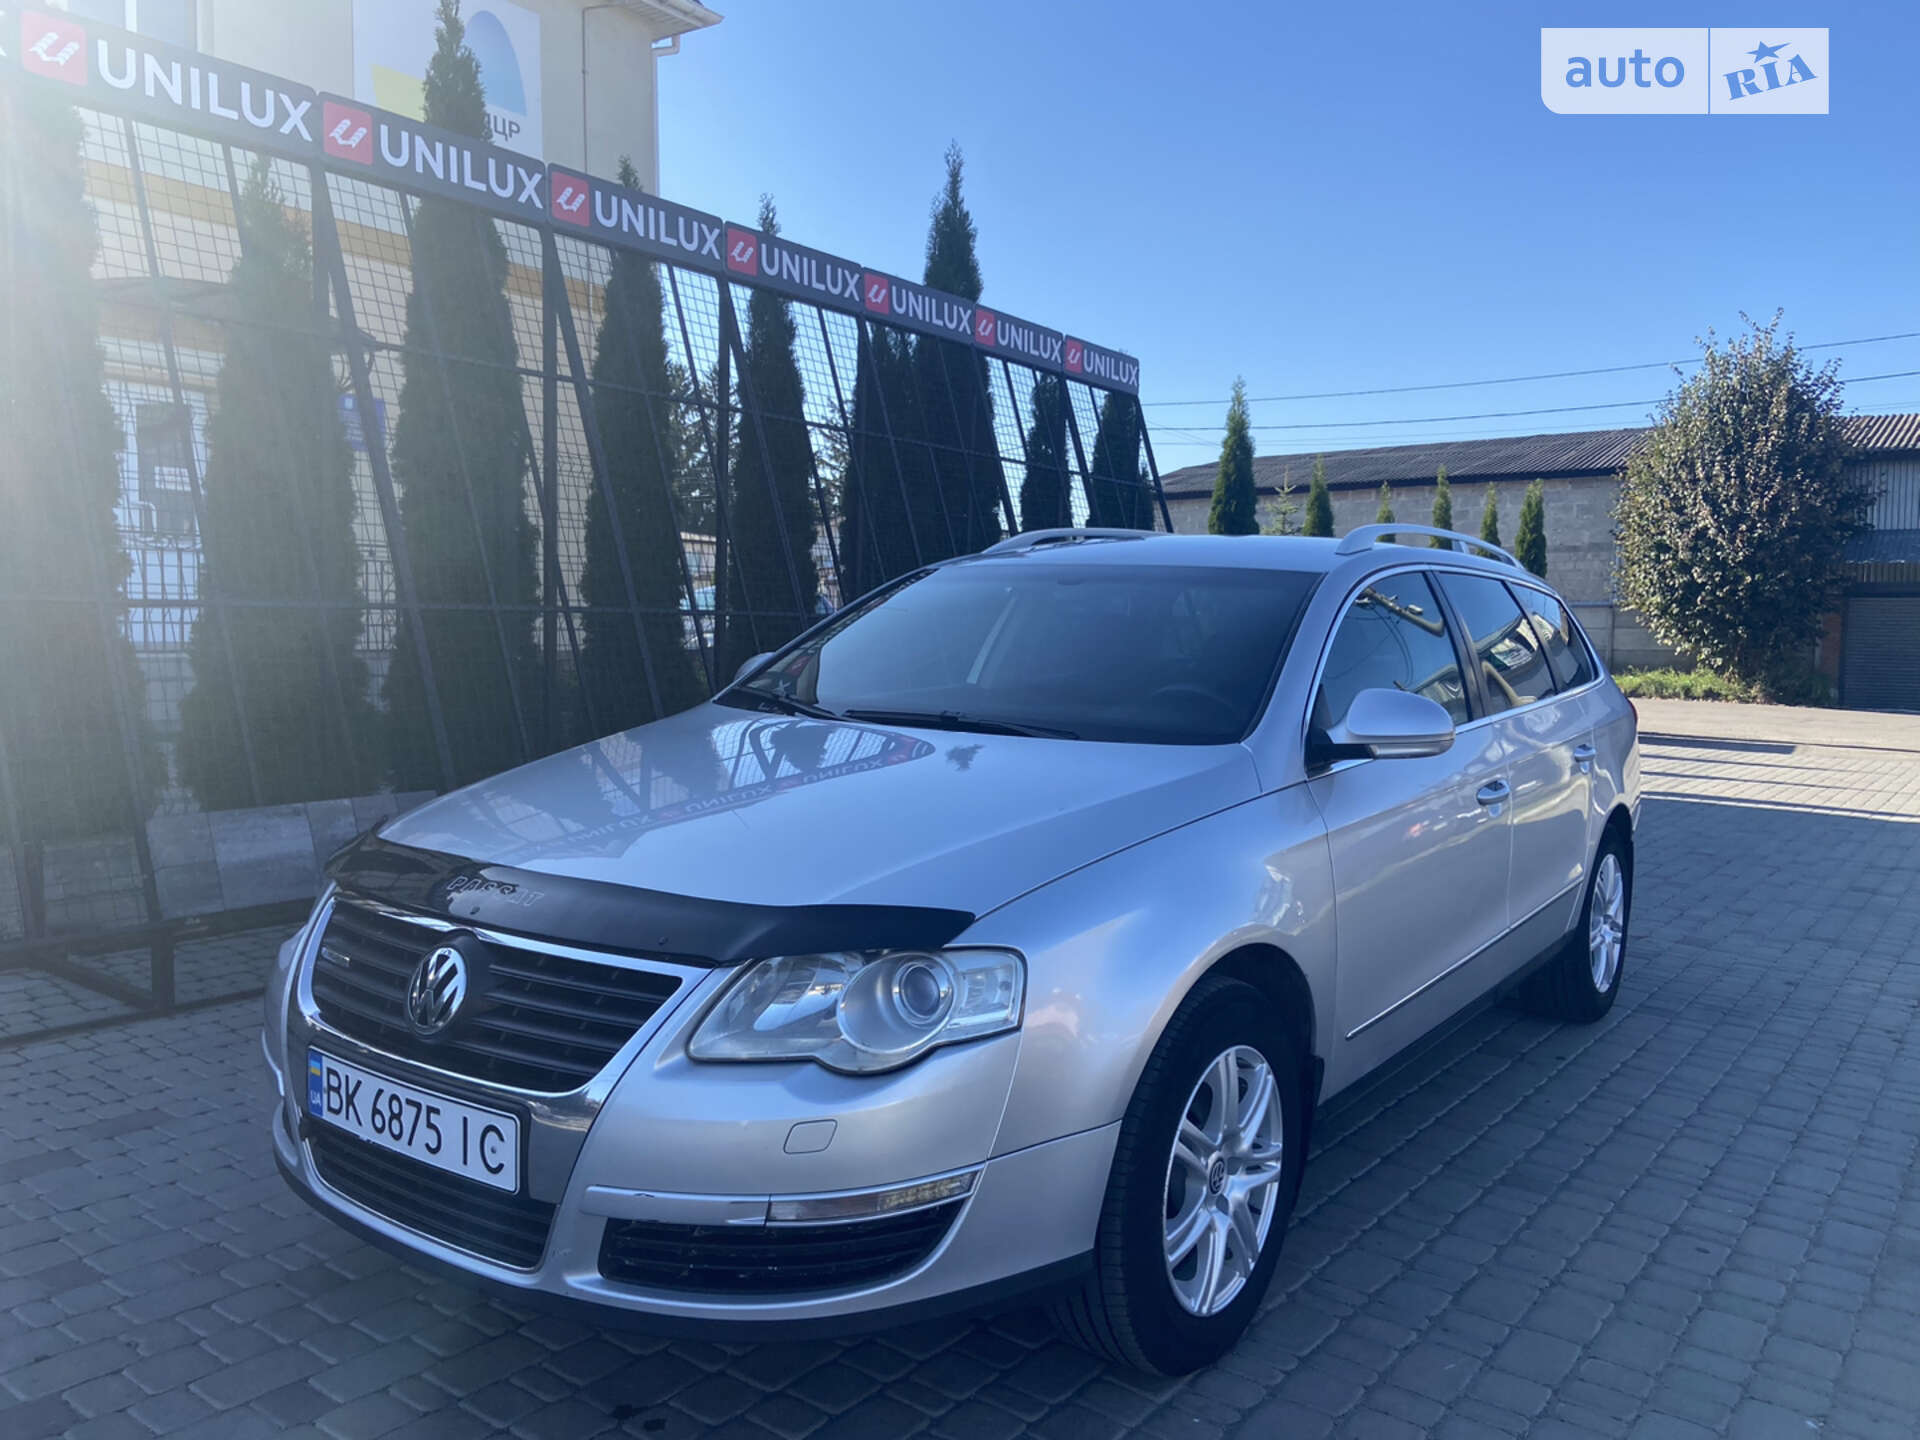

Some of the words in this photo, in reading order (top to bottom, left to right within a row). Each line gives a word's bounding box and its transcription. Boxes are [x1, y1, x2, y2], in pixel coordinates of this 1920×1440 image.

[97, 39, 313, 142] UNILUX
[379, 124, 544, 209] UNILUX
[594, 190, 721, 260] UNILUX
[761, 243, 860, 302] UNILUX
[891, 285, 972, 335] UNILUX
[997, 319, 1062, 364] UNILUX
[1083, 348, 1138, 386] UNILUX
[326, 1066, 363, 1127] BK
[371, 1088, 442, 1155] 6875
[463, 1116, 505, 1175] IC
